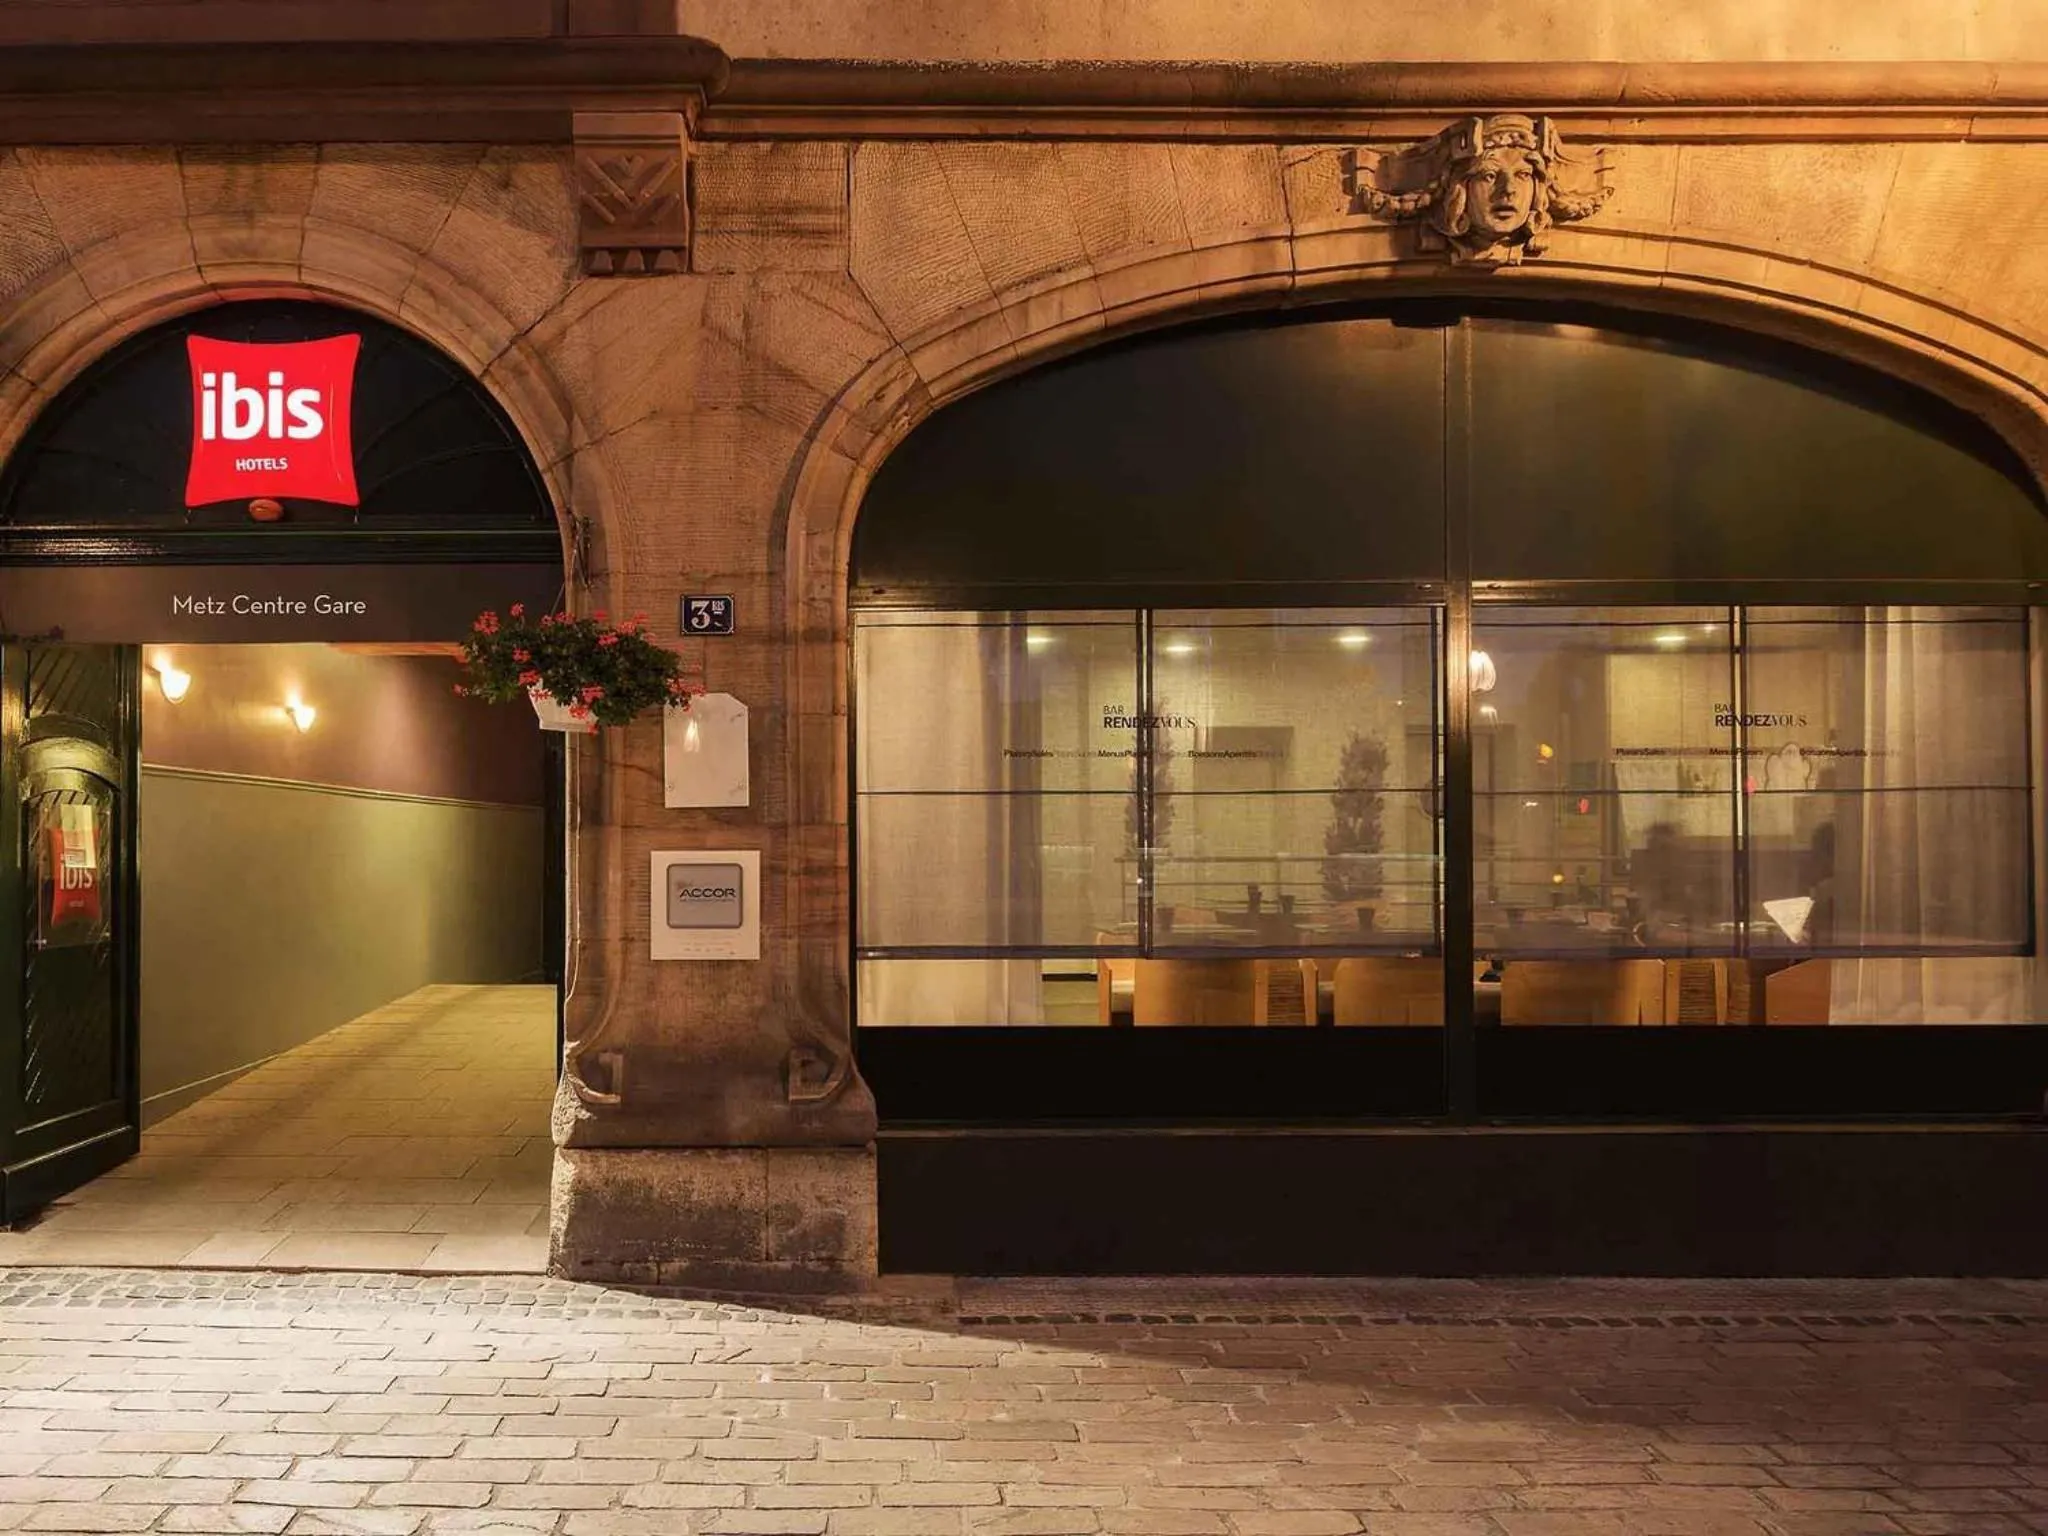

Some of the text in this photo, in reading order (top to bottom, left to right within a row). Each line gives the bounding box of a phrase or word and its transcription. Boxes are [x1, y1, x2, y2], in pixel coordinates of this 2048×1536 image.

[202, 371, 324, 440] ibis
[235, 457, 288, 471] HOTELS
[173, 594, 366, 614] Metz Centre Gare
[691, 600, 711, 629] 3
[1103, 704, 1124, 715] BAR
[1714, 714, 1808, 727] RENDEZVOUS
[679, 887, 737, 898] ACCOR
